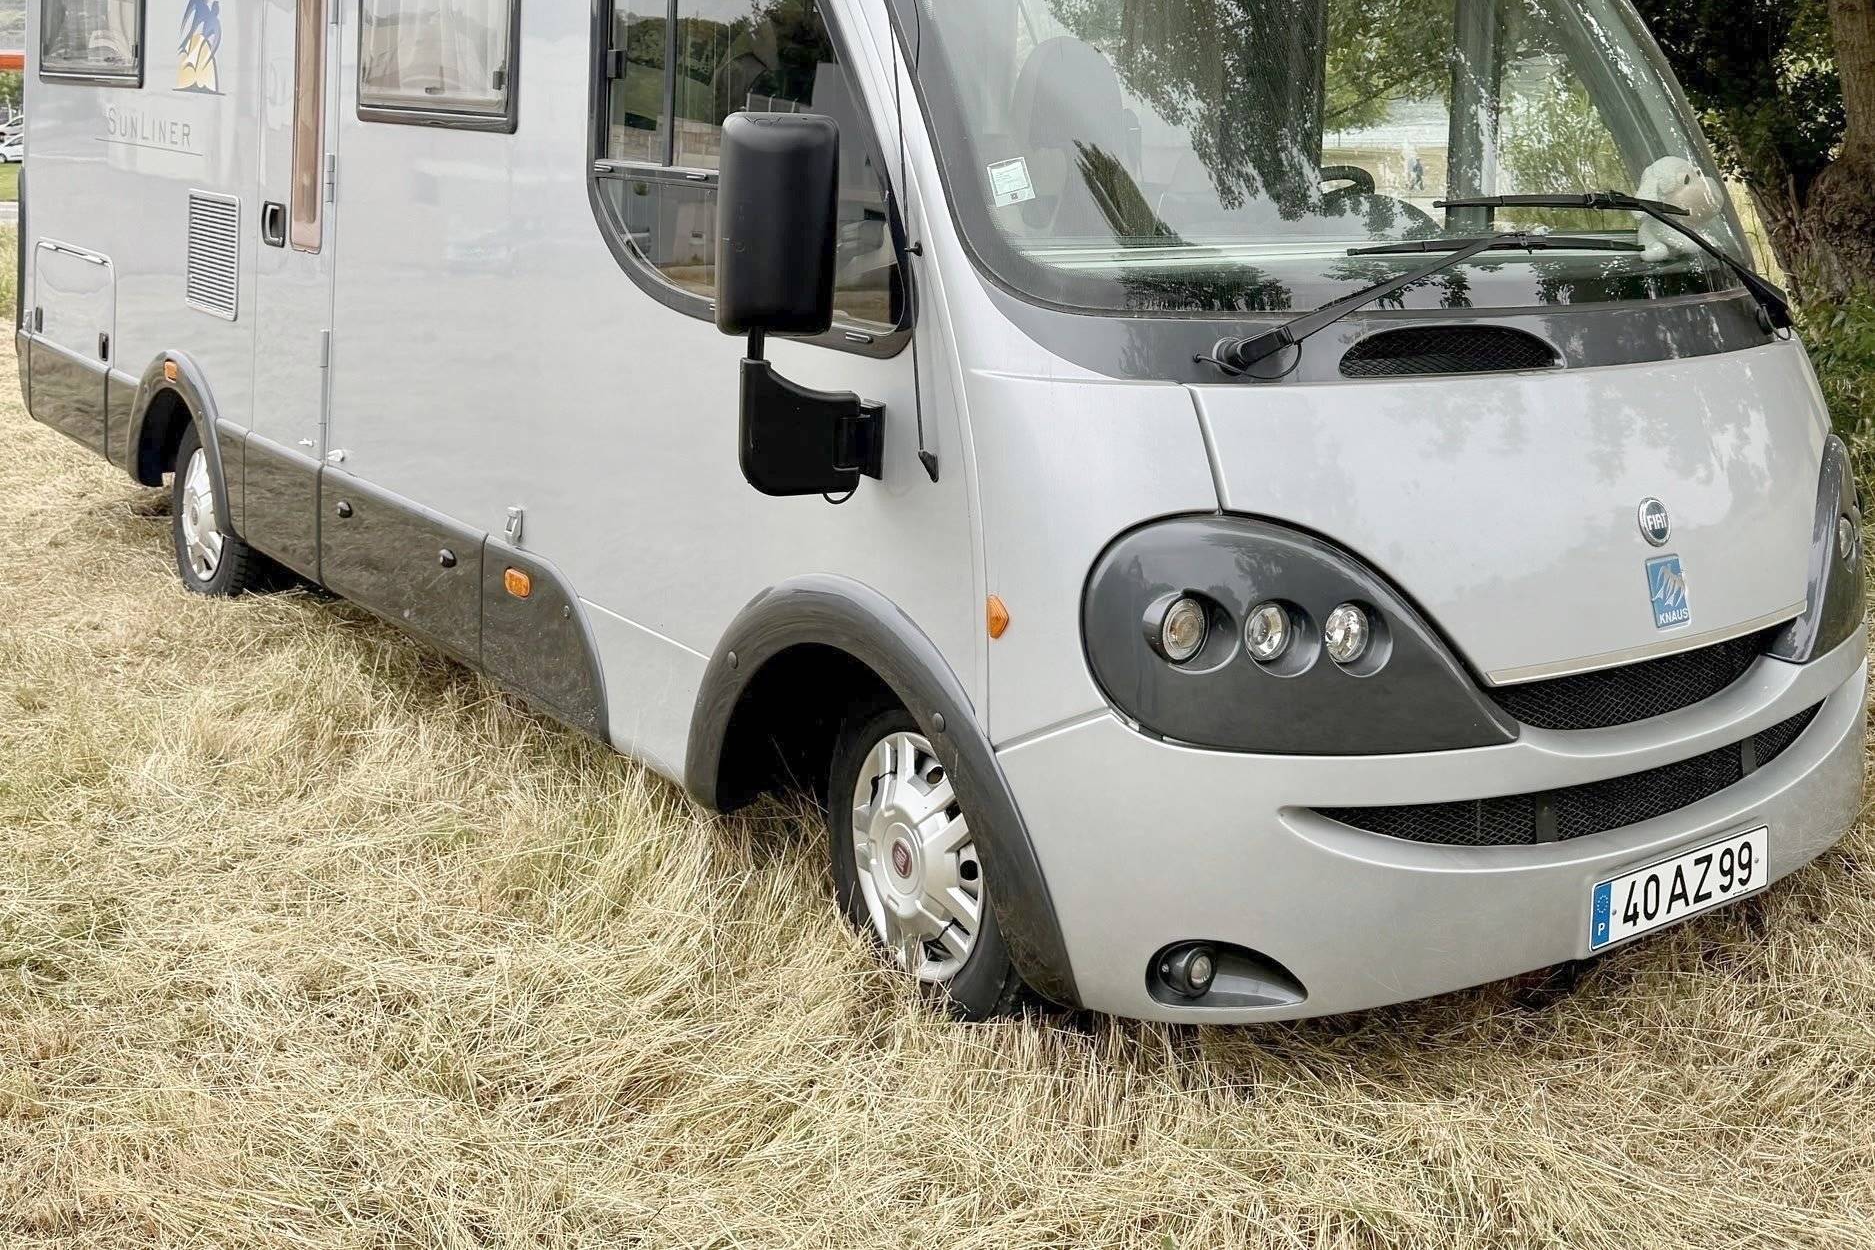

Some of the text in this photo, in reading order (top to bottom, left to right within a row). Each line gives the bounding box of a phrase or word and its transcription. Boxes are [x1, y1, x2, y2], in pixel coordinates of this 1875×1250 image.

[1646, 513, 1668, 531] FIAT
[1659, 608, 1689, 624] KNAUS
[1597, 922, 1606, 936] P
